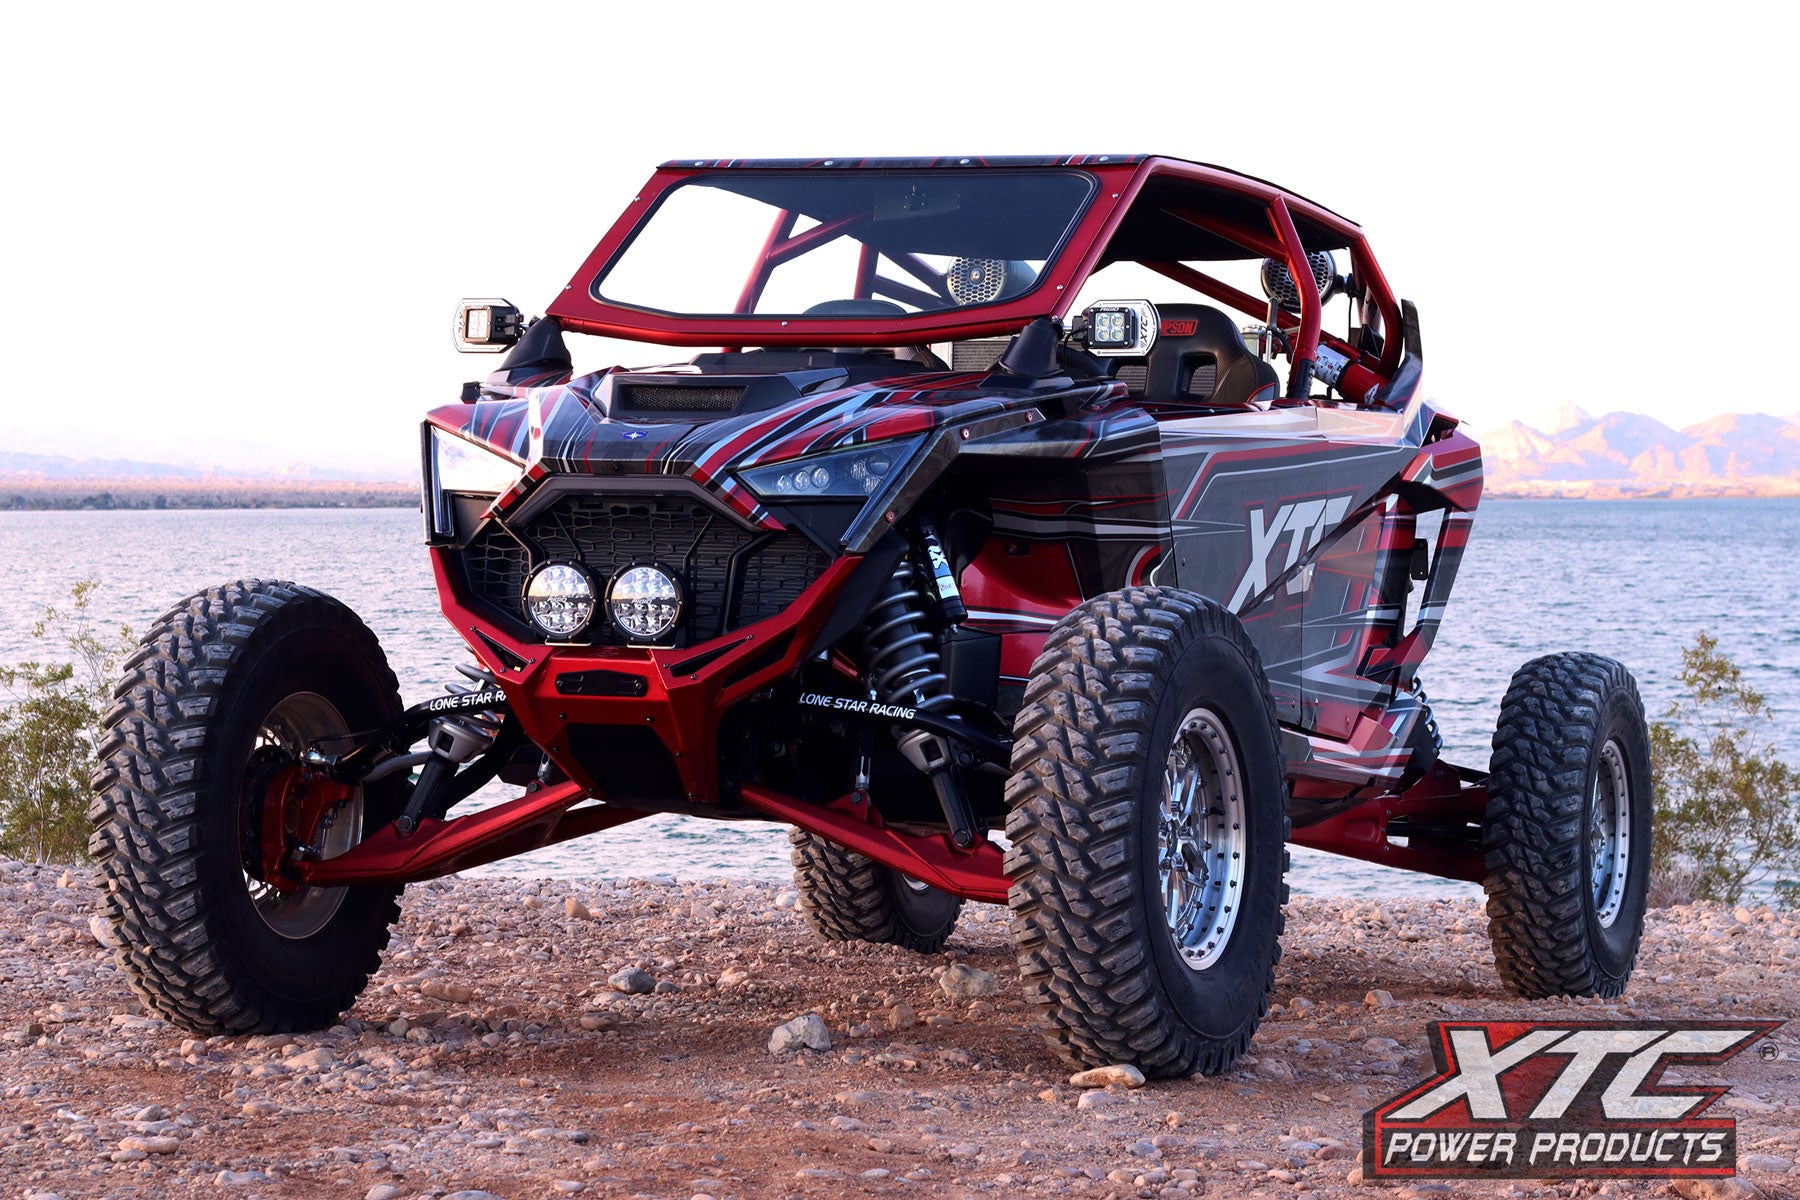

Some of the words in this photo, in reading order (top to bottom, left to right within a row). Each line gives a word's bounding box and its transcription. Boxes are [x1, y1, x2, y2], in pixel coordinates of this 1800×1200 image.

[429, 696, 459, 711] LONE
[461, 692, 492, 707] STAR
[799, 692, 833, 707] LONE
[833, 697, 868, 713] STAR
[869, 703, 917, 719] RACING
